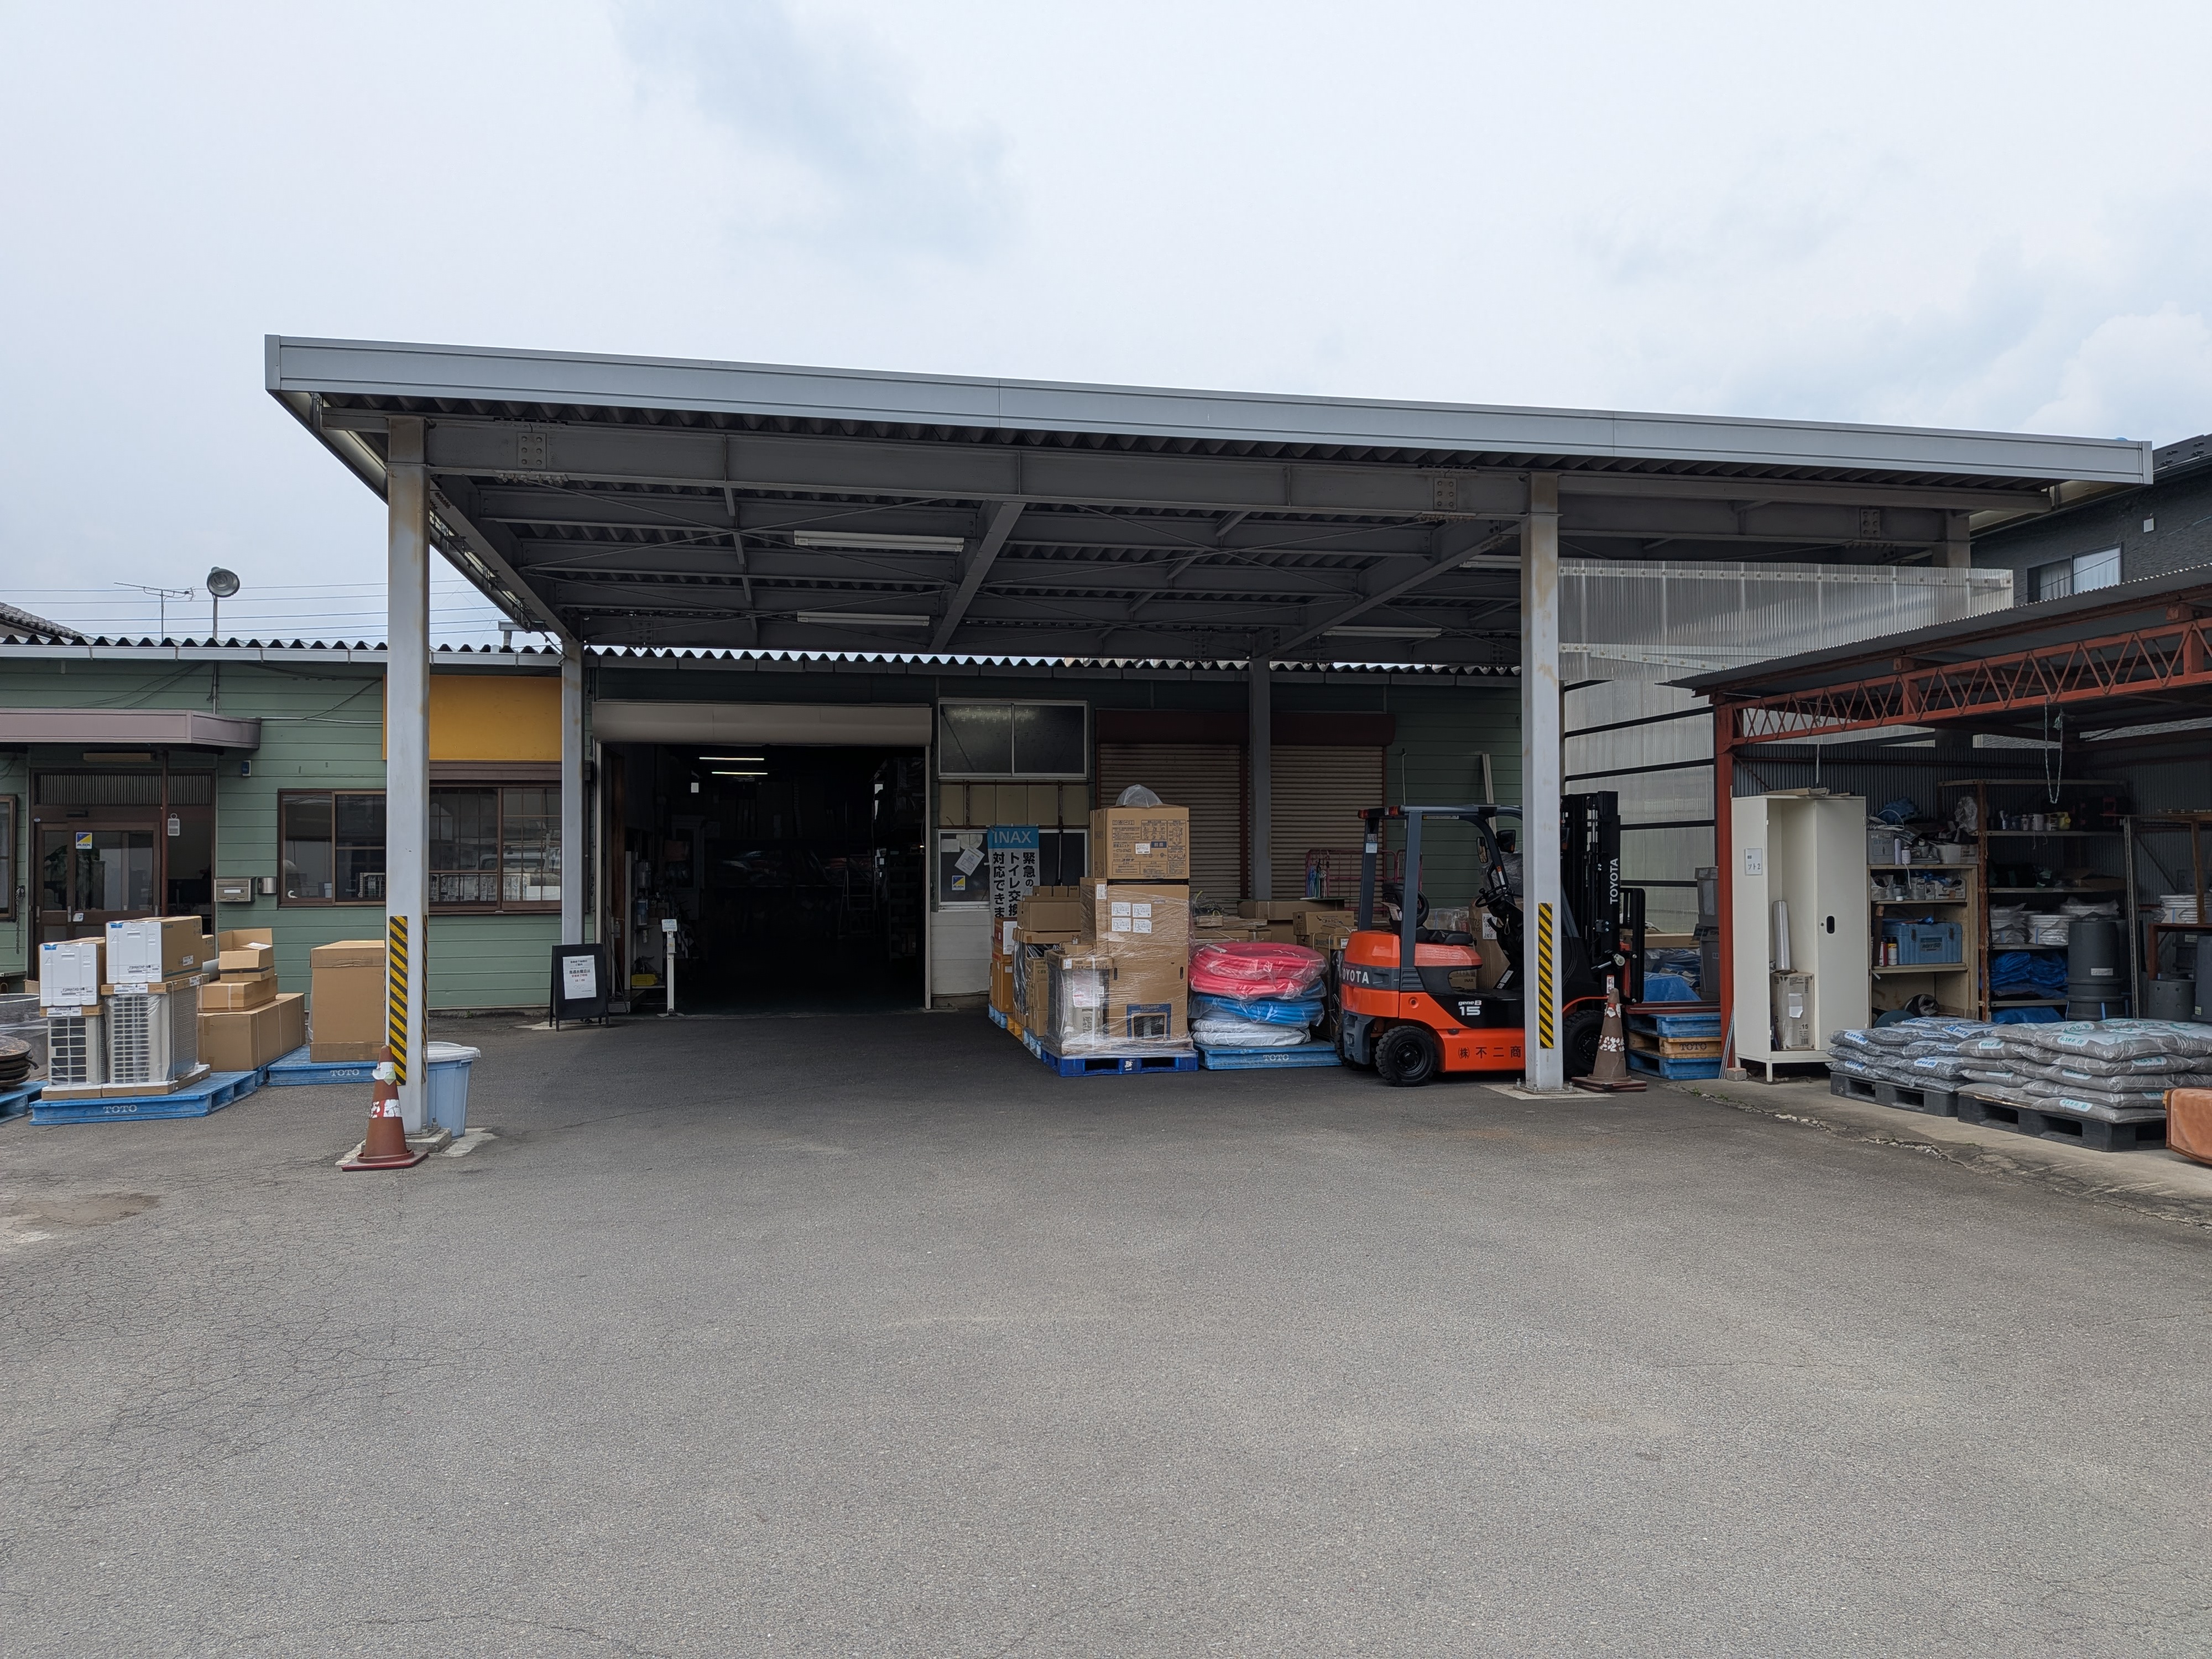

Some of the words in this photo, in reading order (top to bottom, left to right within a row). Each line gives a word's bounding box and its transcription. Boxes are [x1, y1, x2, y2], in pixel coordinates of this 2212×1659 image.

[994, 831, 1032, 843] INAX
[1023, 852, 1036, 887] 緊急の
[993, 852, 1005, 918] 対応できま
[1610, 858, 1619, 905] TOYOTA
[1342, 968, 1370, 984] OYOTA
[1459, 1006, 1480, 1016] 15
[102, 1105, 138, 1114] TOTO
